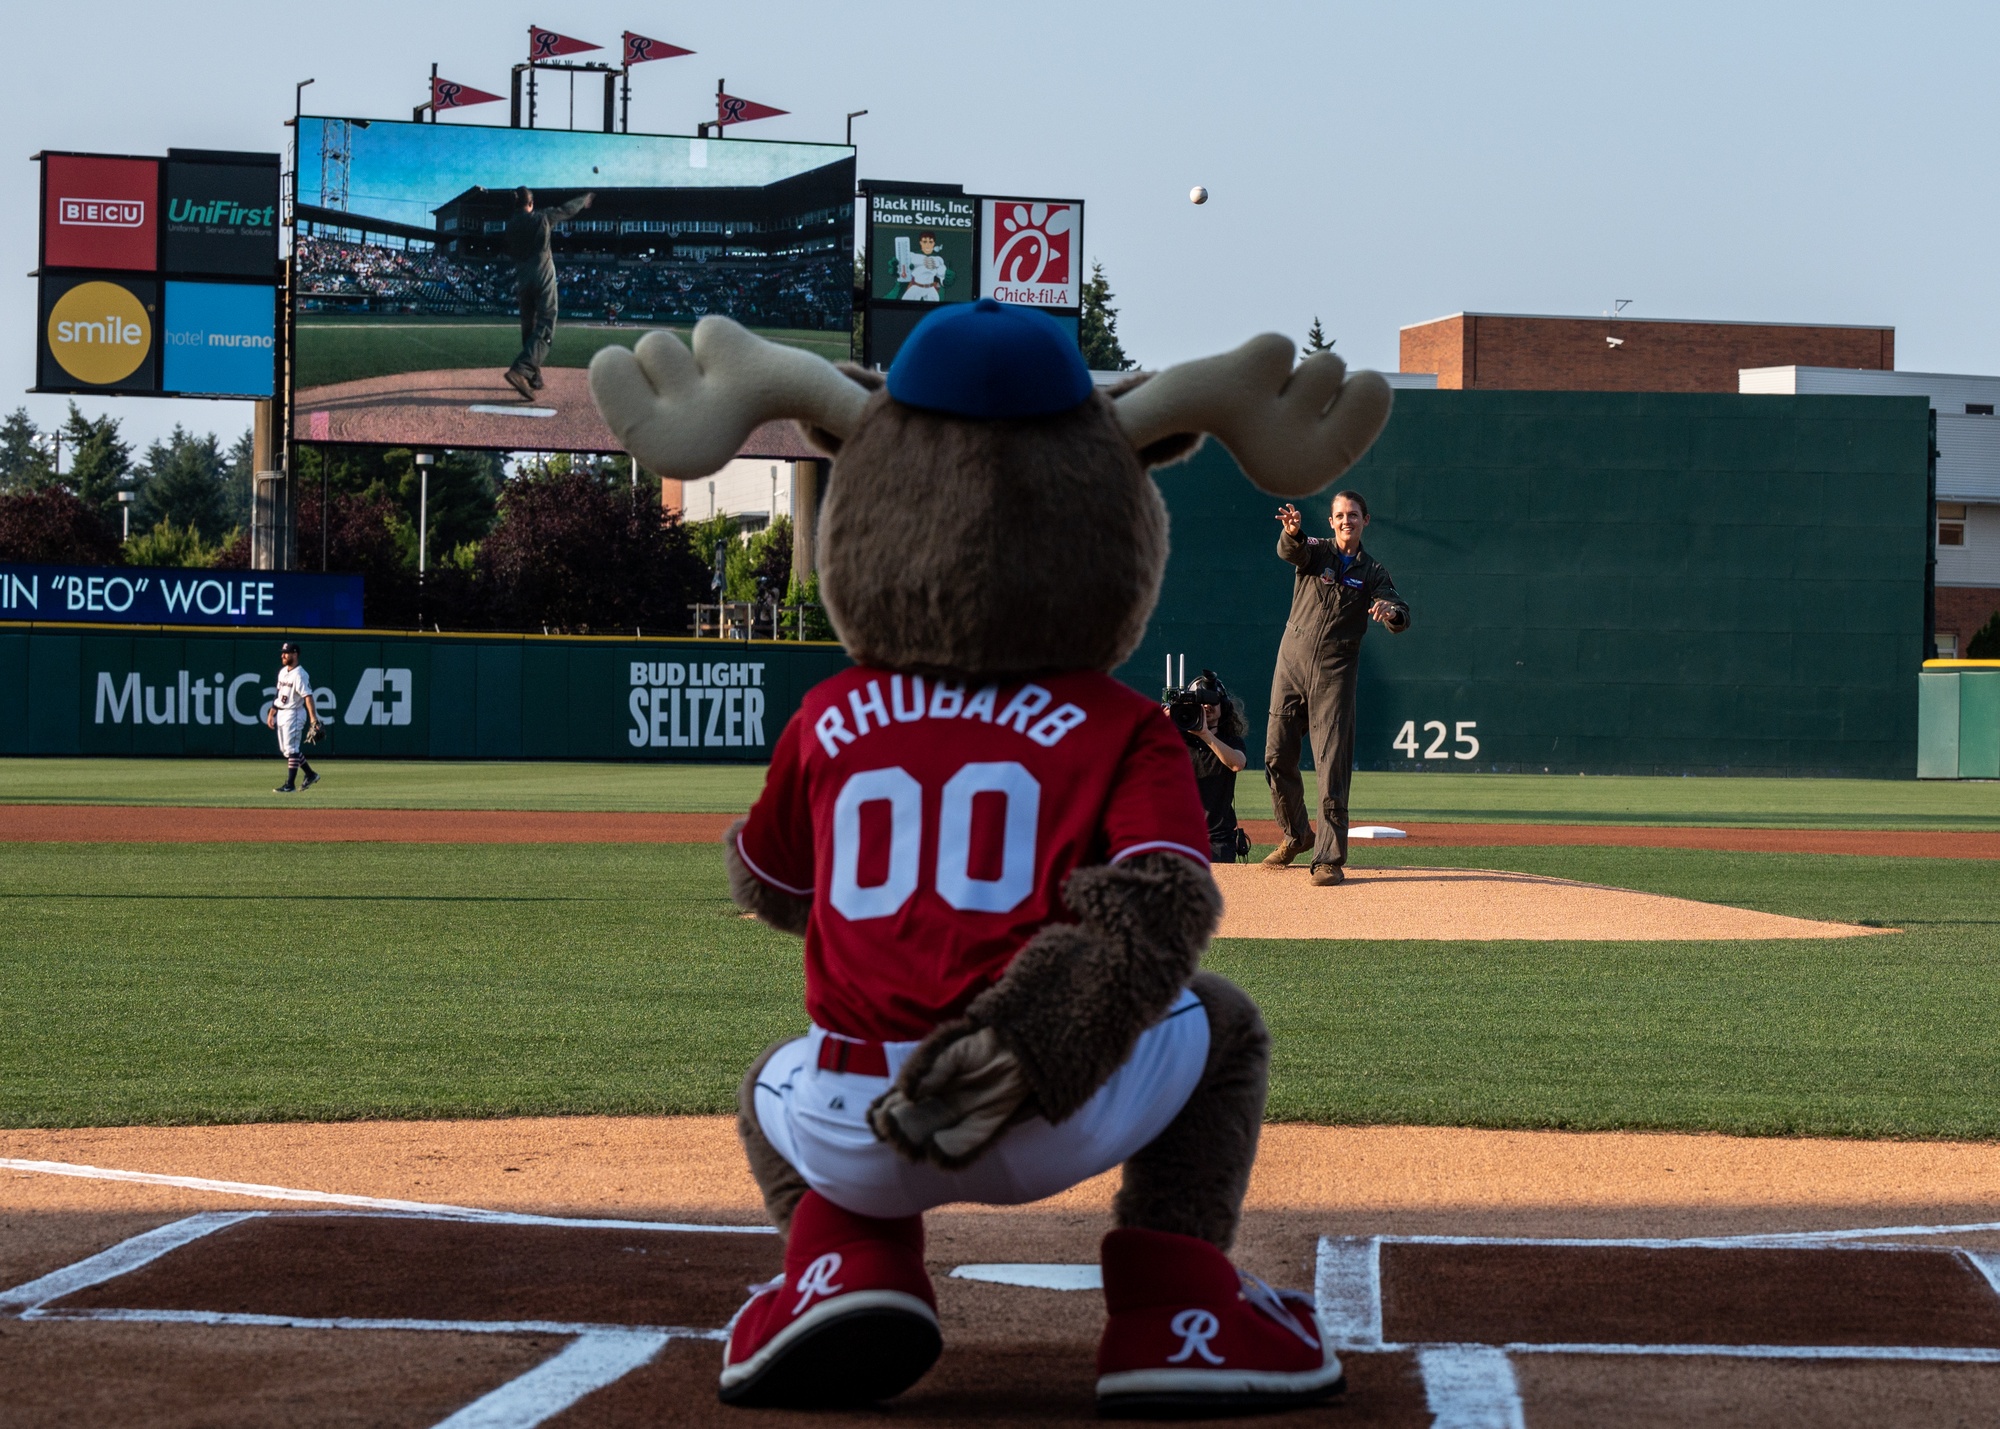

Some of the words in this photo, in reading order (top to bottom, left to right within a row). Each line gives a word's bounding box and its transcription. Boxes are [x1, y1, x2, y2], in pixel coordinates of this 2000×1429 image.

[67, 204, 138, 222] BECU
[168, 197, 275, 227] UniFirst
[873, 196, 908, 212] Black
[911, 198, 946, 215] Hills,
[948, 200, 973, 215] Inc.
[873, 211, 913, 225] Home
[915, 212, 972, 228] Services
[168, 224, 200, 233] Uniforms
[205, 226, 235, 235] Services
[241, 228, 272, 237] Solutions
[993, 286, 1067, 305] Chick-fil-A
[57, 315, 142, 345] smile
[165, 329, 204, 347] hotel
[208, 333, 273, 348] murano
[0, 573, 38, 611] IN
[160, 579, 274, 616] WOLFE
[630, 662, 686, 686] BUD
[689, 662, 765, 687] LIGHT
[95, 669, 337, 726] MultiCae
[628, 687, 766, 747] SELTZER
[814, 673, 1088, 759] RHUBARB
[1393, 720, 1480, 760] 425
[829, 761, 1041, 922] 00
[1166, 1307, 1226, 1365] R
